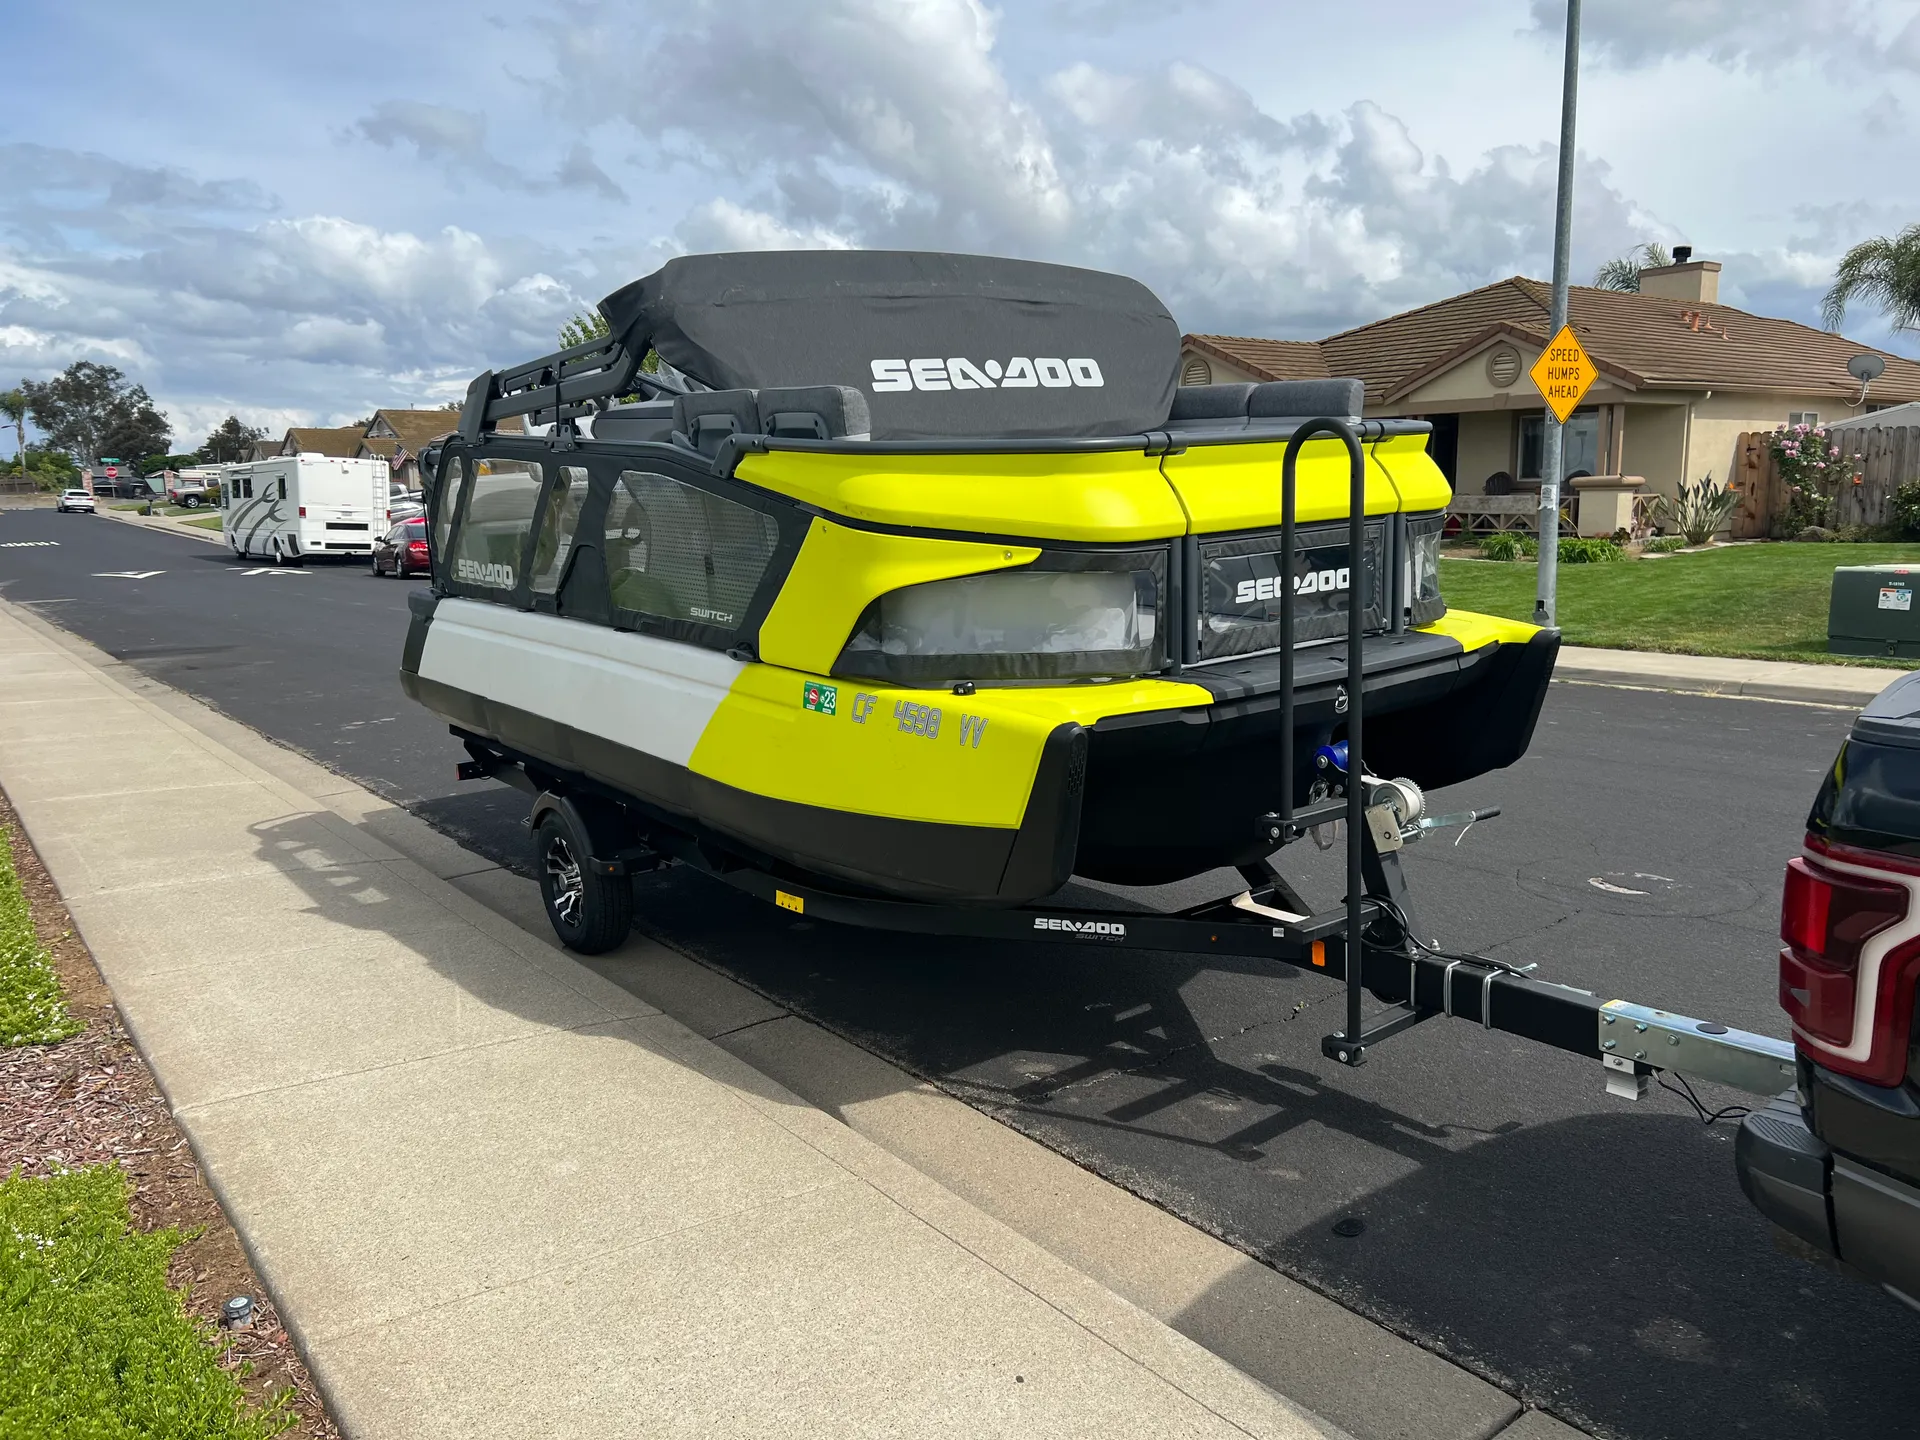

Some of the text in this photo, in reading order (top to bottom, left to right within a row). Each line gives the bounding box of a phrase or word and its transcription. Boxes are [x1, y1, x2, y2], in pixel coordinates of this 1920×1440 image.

[1550, 348, 1579, 362] SPEED
[1547, 367, 1580, 381] HUMPS
[1548, 385, 1579, 398] AHEAD
[690, 607, 733, 623] SWITCH
[823, 690, 836, 709] 23
[852, 693, 878, 724] CF
[893, 700, 942, 739] 4598
[1075, 933, 1125, 942] SWITCH
